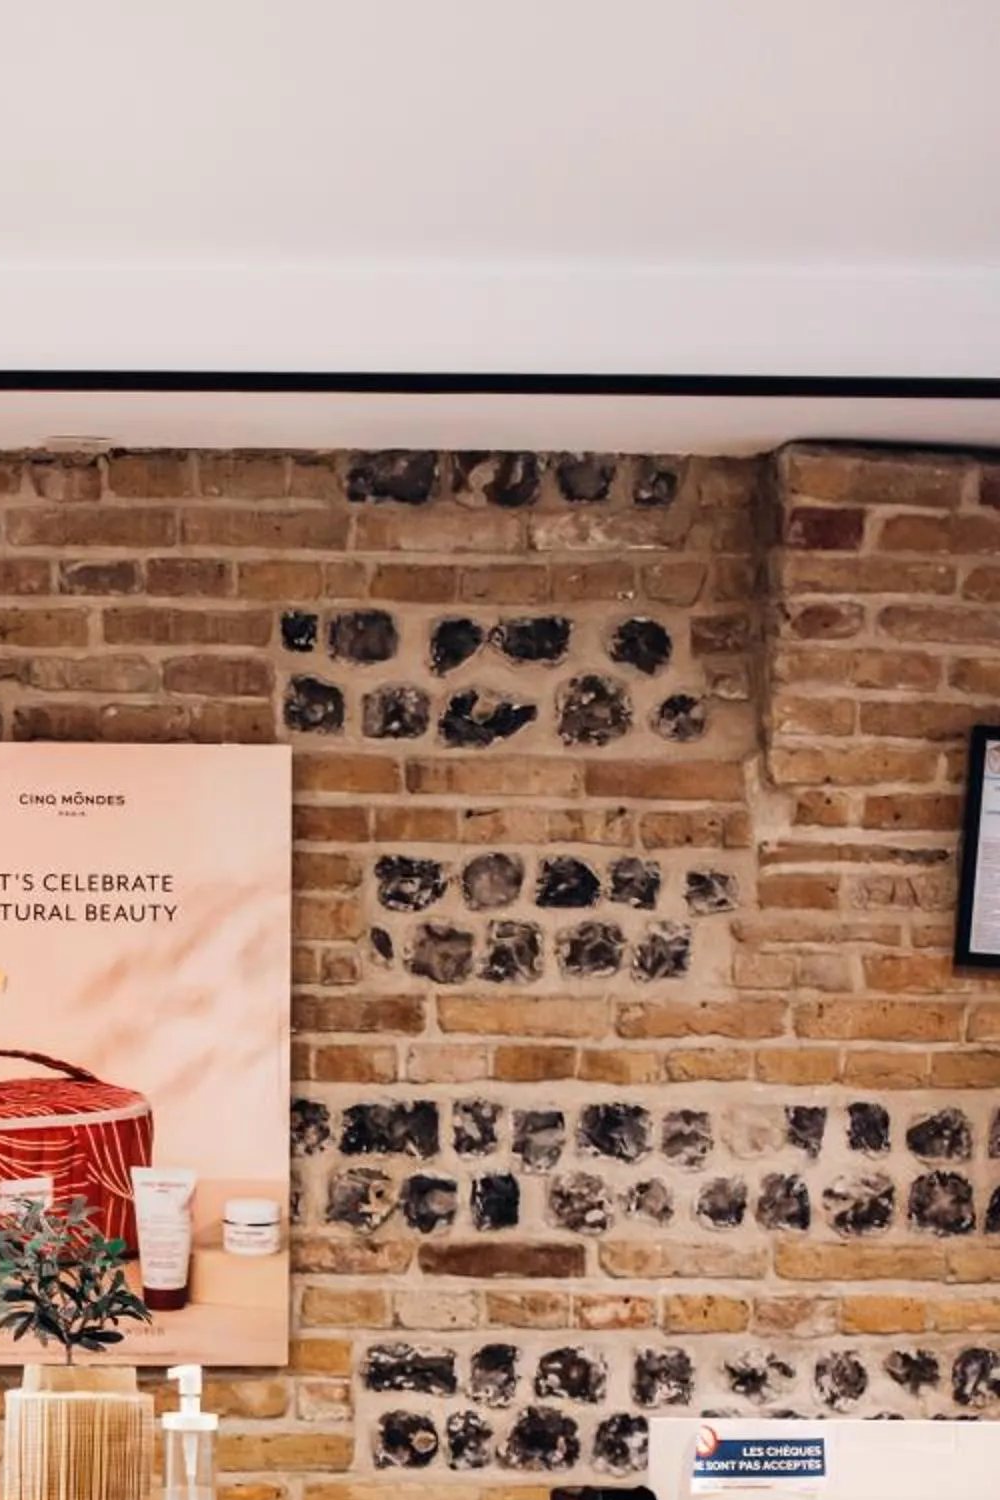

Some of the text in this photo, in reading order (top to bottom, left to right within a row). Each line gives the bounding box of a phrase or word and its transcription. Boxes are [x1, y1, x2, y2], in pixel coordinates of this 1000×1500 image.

[19, 793, 57, 806] CINQ
[43, 874, 173, 893] CELEBRATE
[85, 904, 178, 923] BEAUTY
[742, 1446, 764, 1457] LES
[706, 1460, 736, 1471] SONT
[739, 1460, 761, 1471] PAS
